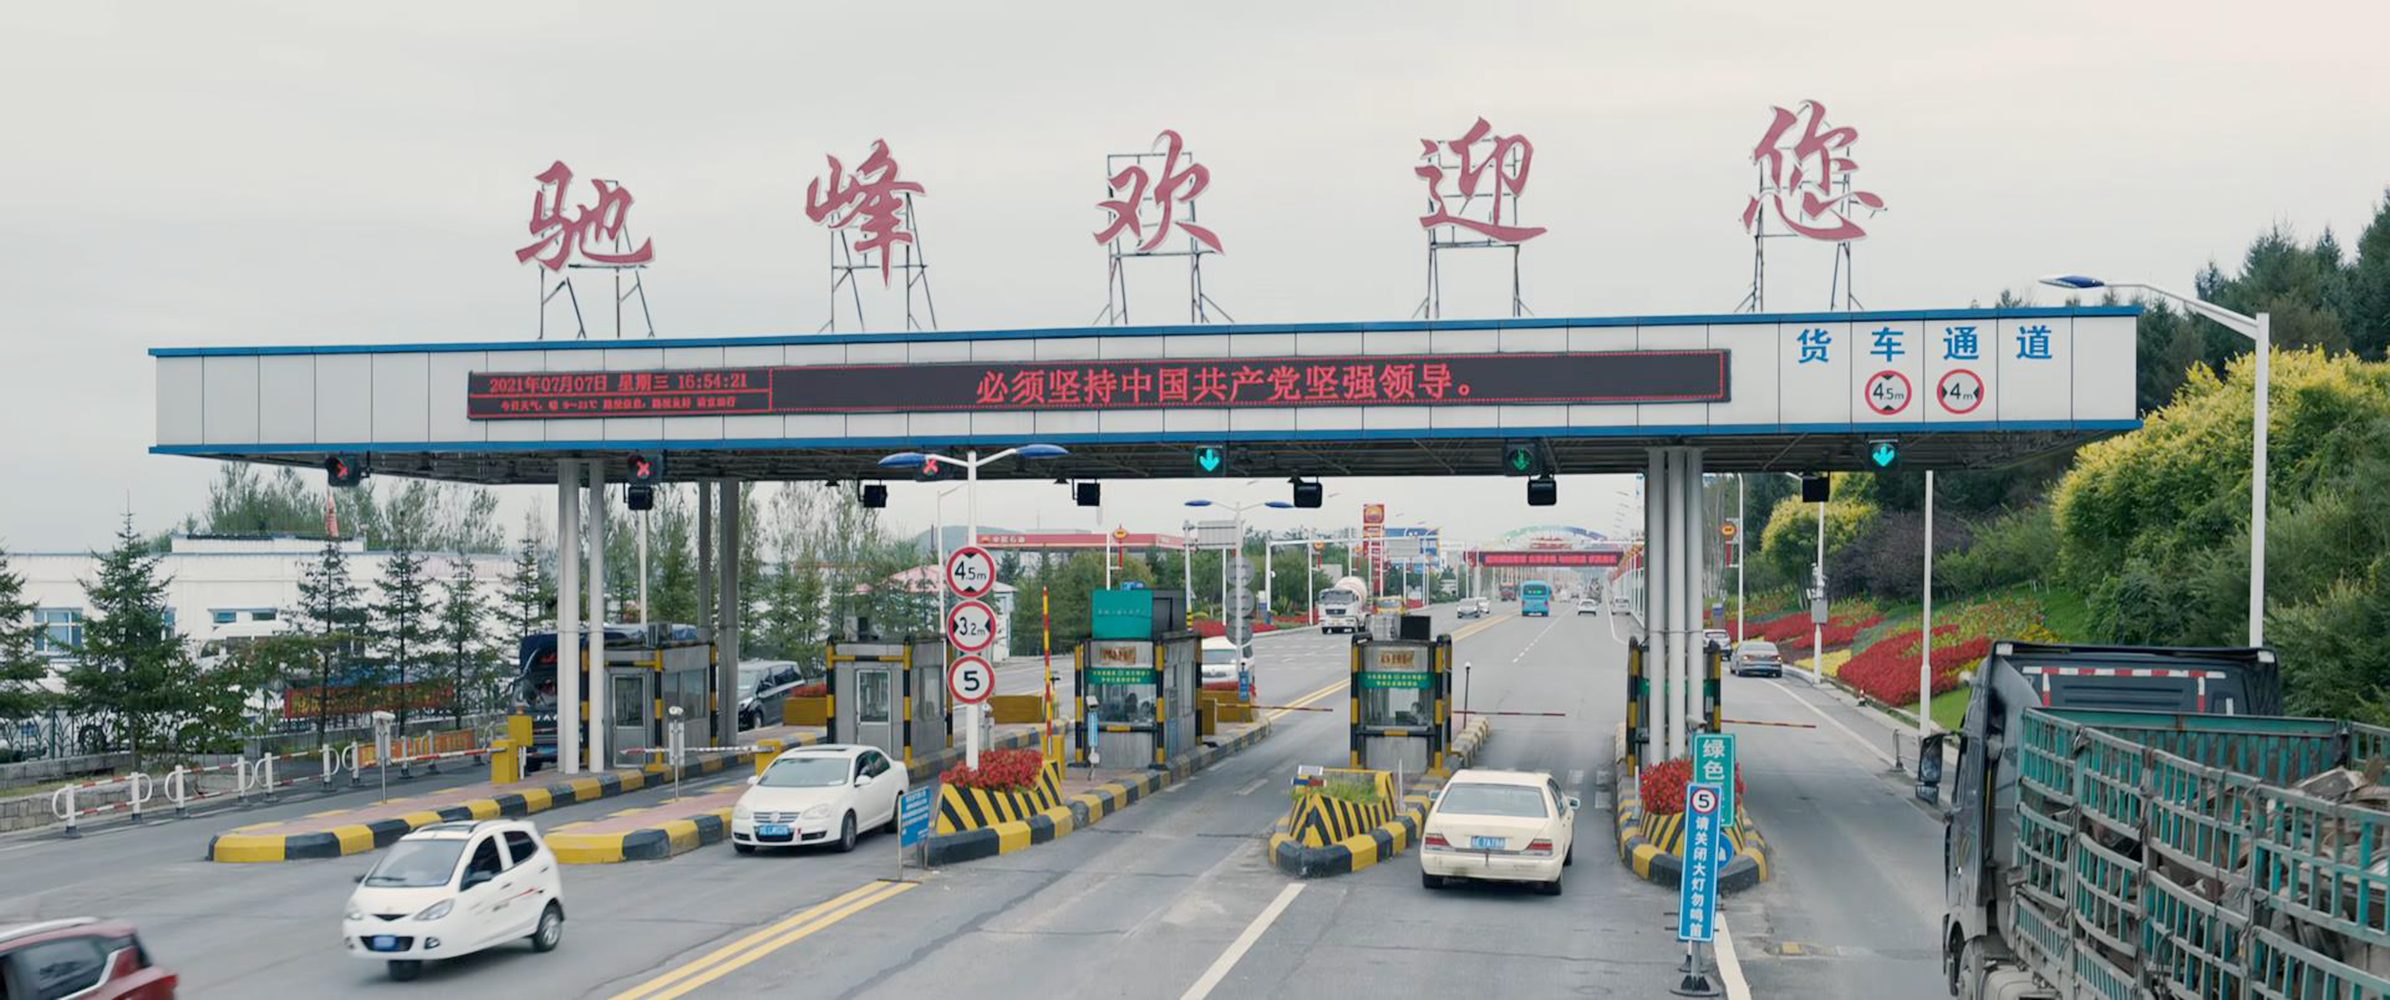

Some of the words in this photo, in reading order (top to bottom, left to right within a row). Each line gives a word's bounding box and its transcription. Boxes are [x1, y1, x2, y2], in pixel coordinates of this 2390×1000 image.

[1797, 325, 2053, 363] 货车通道
[489, 373, 607, 393] 2021年07月07日
[617, 372, 669, 391] 星期三
[678, 372, 748, 389] 16:54:21
[976, 363, 1471, 403] 必须坚持中国共产党坚强领导。
[1873, 382, 1904, 400] 4.5m
[955, 561, 987, 580] 4.5m
[959, 616, 985, 636] 3.2m
[964, 671, 980, 691] 5
[1698, 793, 1710, 808] 5
[1690, 816, 1709, 937] 请关闭大灯勿鸣笛
